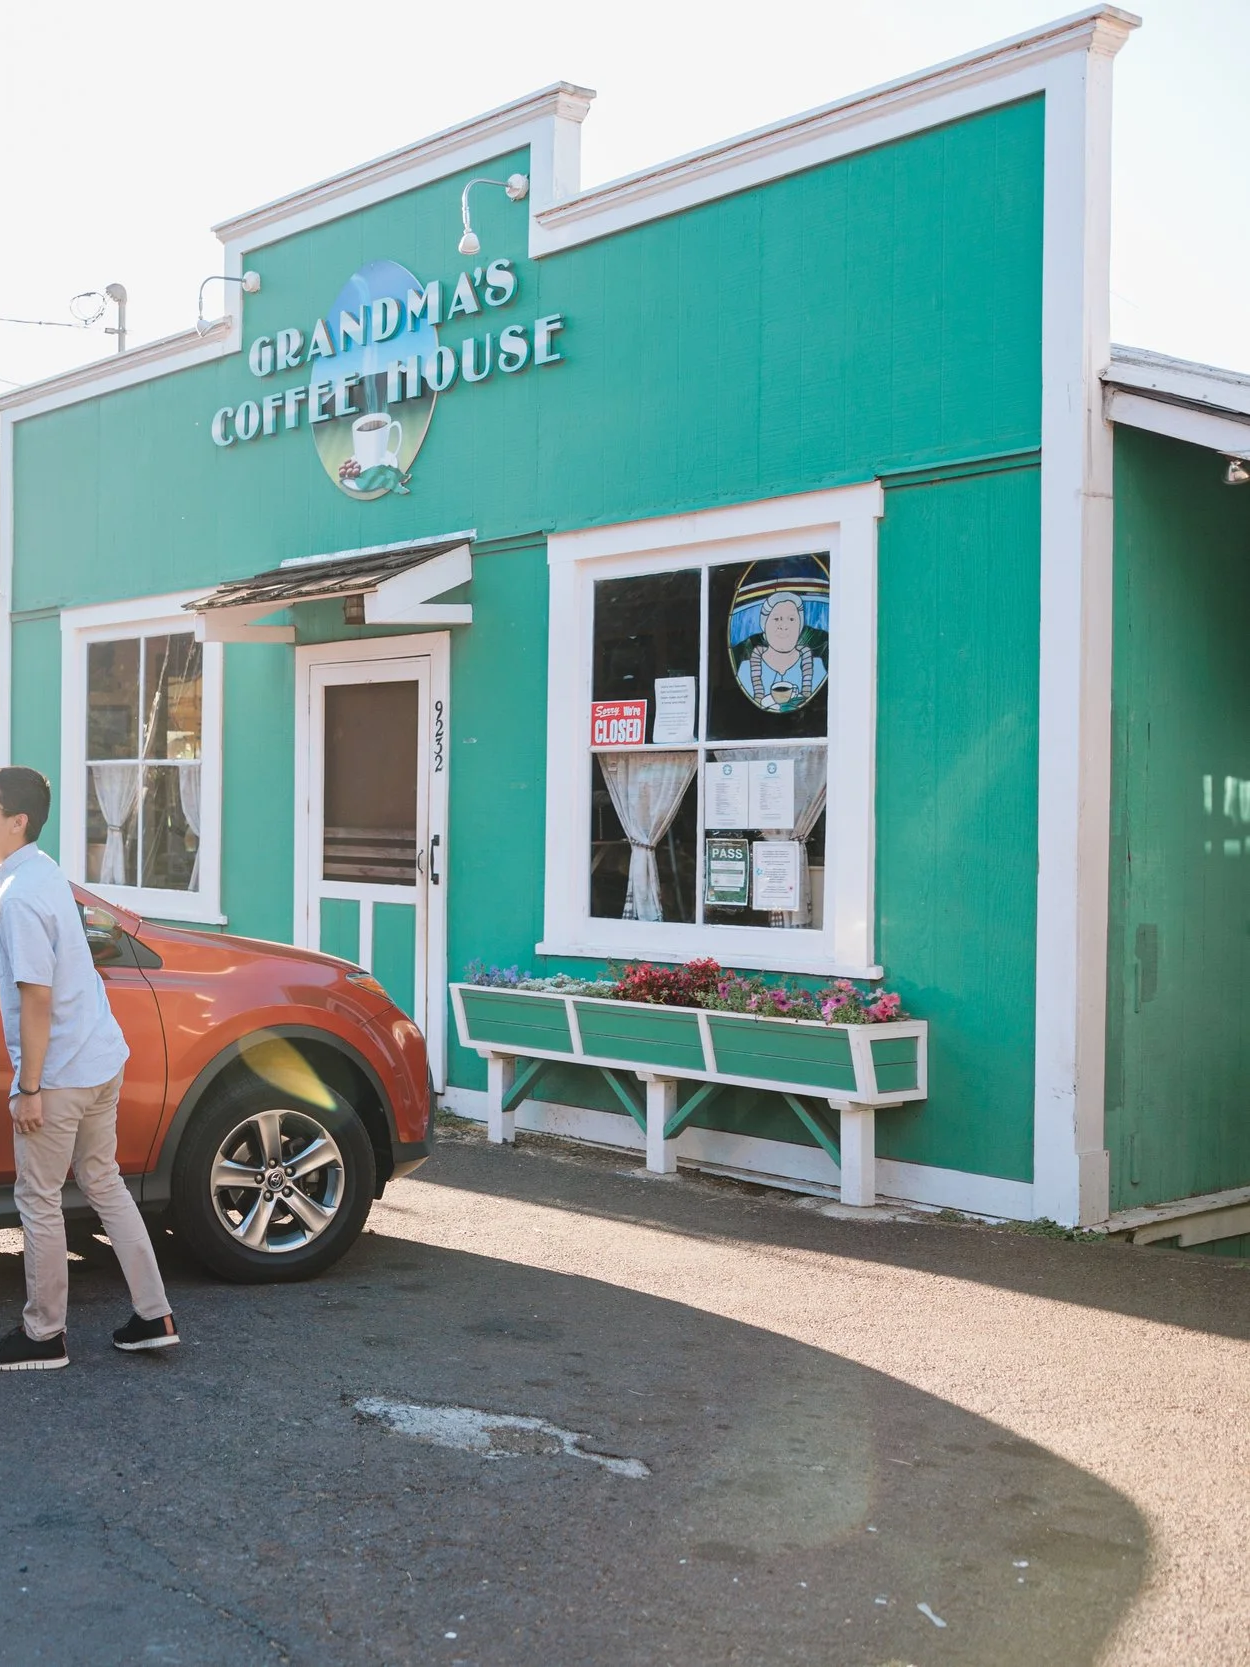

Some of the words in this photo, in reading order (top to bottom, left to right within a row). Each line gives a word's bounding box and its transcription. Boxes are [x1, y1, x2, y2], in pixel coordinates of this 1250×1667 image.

[249, 258, 519, 377] GRANDMA'S
[211, 372, 361, 447] COFFEE
[386, 313, 566, 403] HOUSE
[594, 705, 621, 718] Sorry
[594, 719, 642, 743] CLOSED
[434, 700, 444, 773] 9232
[712, 848, 743, 859] PASS
